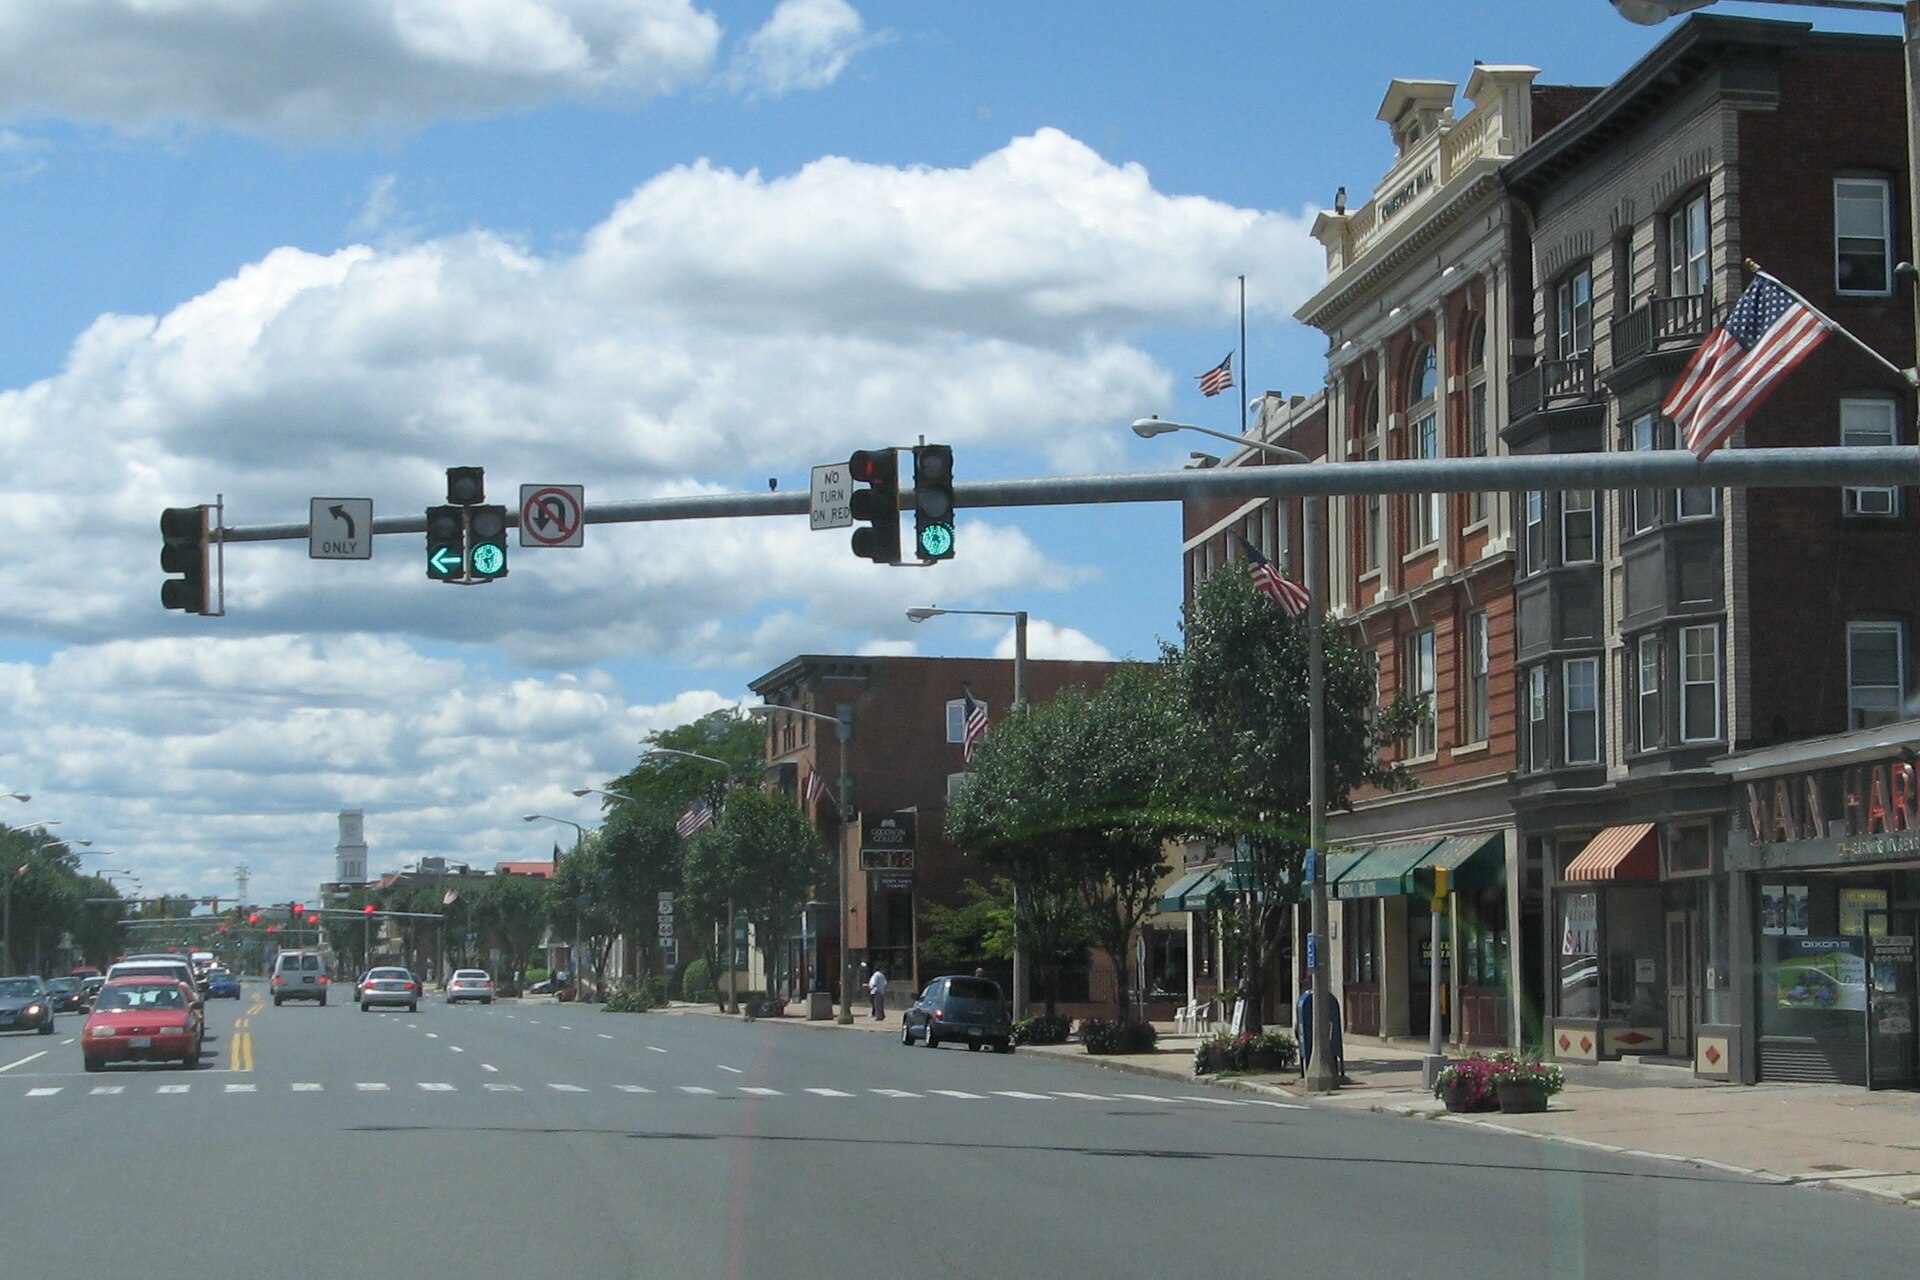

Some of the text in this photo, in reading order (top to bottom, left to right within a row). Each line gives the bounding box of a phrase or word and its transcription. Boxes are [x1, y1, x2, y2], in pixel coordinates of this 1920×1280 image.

[824, 471, 840, 485] NO
[820, 489, 844, 503] TURN
[813, 506, 850, 522] ON RED
[322, 541, 358, 554] ONLY
[1747, 759, 1920, 843] VAN HAR
